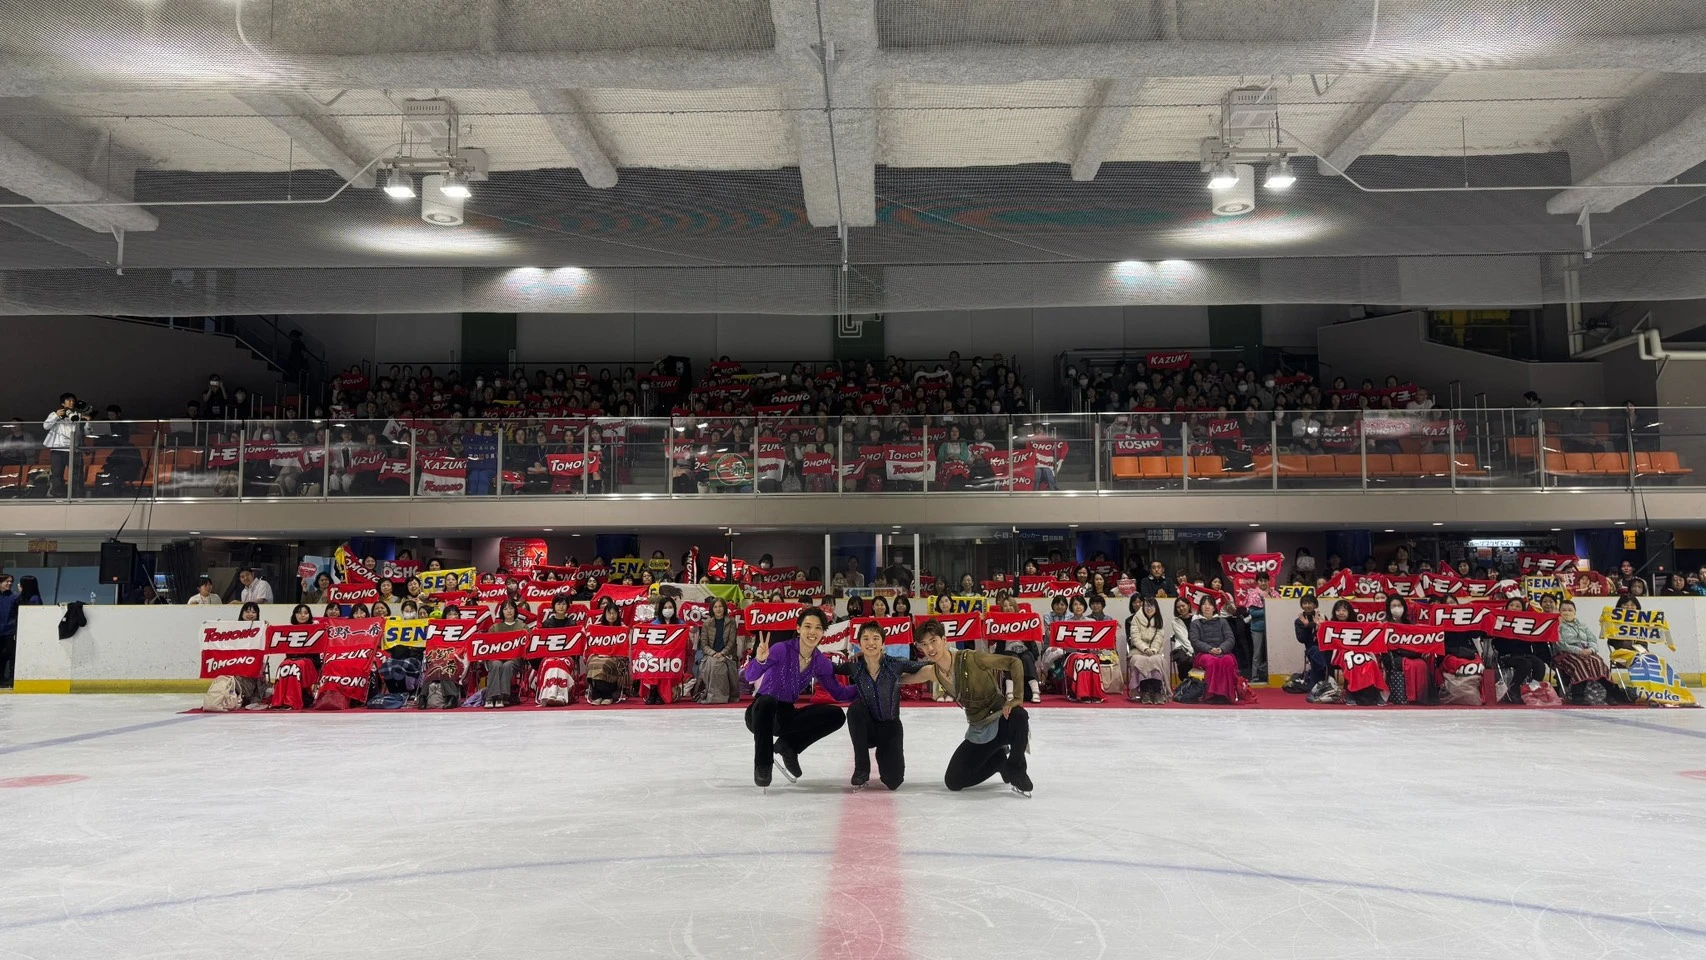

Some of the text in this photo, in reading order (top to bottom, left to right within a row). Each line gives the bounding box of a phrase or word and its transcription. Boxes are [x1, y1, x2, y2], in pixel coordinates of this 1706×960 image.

[1151, 354, 1187, 364] KAZUKI
[423, 458, 467, 470] KAZUKI
[1227, 560, 1277, 573] KOSHO
[424, 573, 470, 589] SEA
[329, 587, 377, 601] TOMONO
[527, 586, 570, 597] TOMONO
[1282, 586, 1316, 598] ENA
[1436, 607, 1491, 626] トモノ
[1611, 609, 1664, 624] SENA
[386, 625, 428, 642] SEN
[427, 624, 478, 642] トモノ
[851, 621, 910, 640] TONO
[942, 619, 975, 637] モノ
[984, 617, 1041, 635] TOMONO
[1056, 626, 1113, 643] トモノ
[1494, 616, 1555, 636] トモノ
[1618, 625, 1661, 639] SENA
[203, 627, 260, 643] TOMONO
[270, 630, 327, 648] トモノ
[529, 632, 583, 653] トモノ
[632, 627, 685, 645] トモノ
[1324, 627, 1382, 646] トモノ
[1384, 628, 1445, 645] TOMONO
[472, 635, 527, 657] TOMONO
[205, 656, 255, 673] TOMONO
[633, 657, 682, 674] KOSHO
